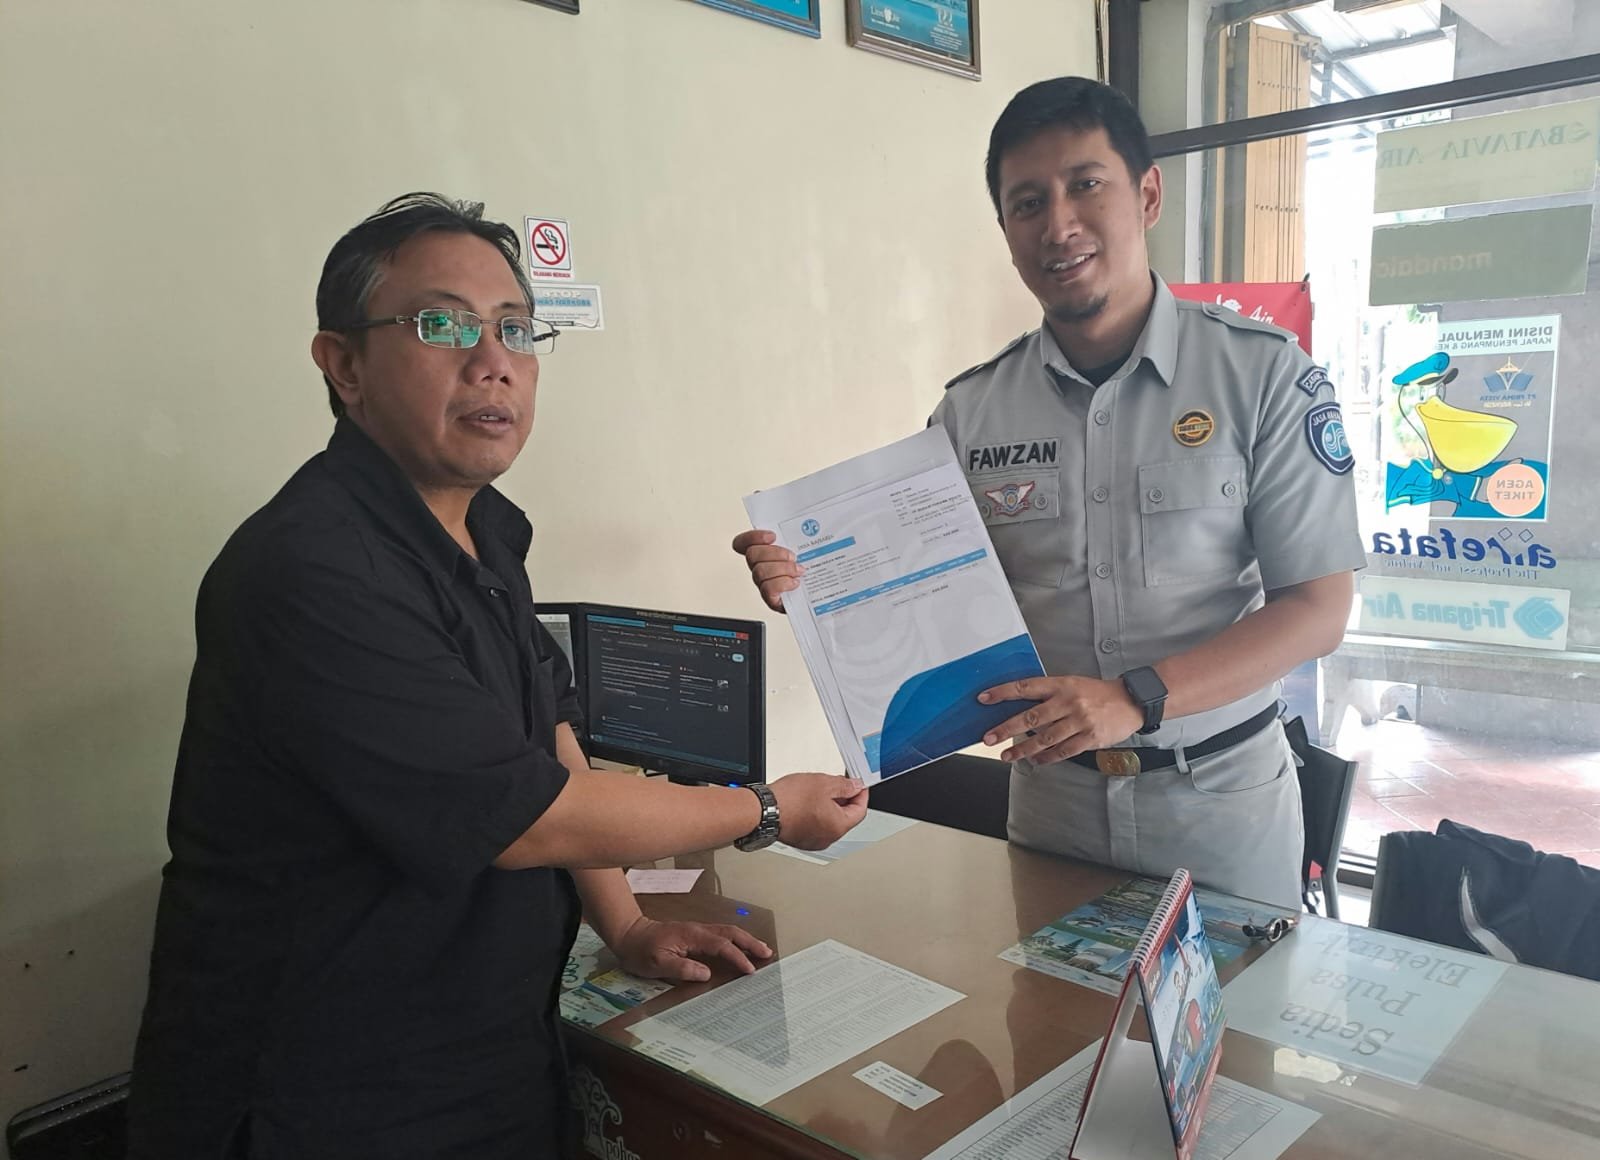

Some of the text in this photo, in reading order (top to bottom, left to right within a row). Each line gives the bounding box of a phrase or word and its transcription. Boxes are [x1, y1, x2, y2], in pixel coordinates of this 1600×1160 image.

[969, 441, 1057, 471] FAWZAN
[1310, 968, 1421, 1017] Pulsa
[1280, 1003, 1394, 1056] Sedia
